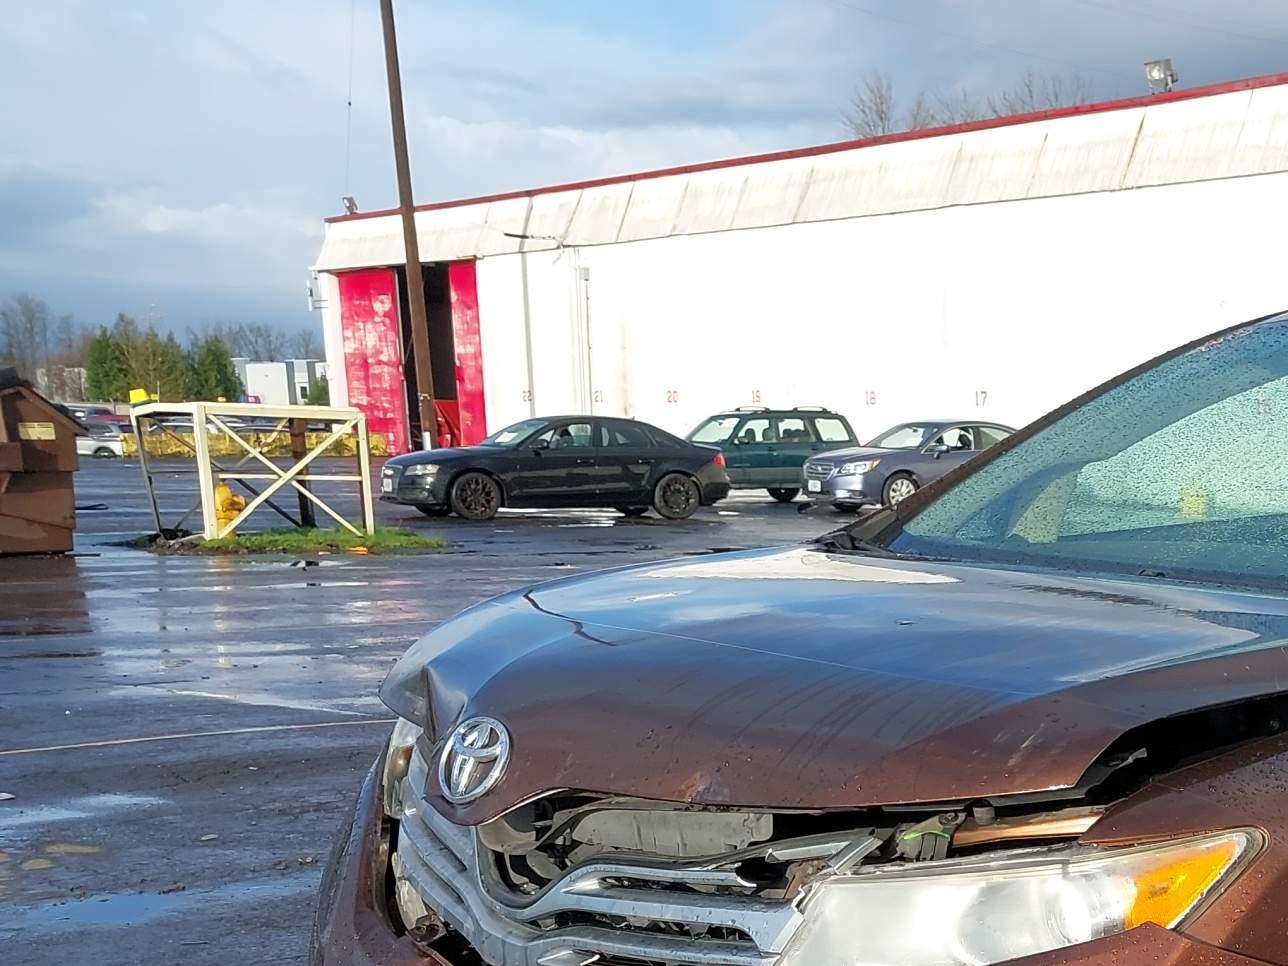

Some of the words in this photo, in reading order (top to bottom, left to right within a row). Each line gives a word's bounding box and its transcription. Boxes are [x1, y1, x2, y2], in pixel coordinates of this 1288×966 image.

[593, 390, 604, 403] 21
[666, 390, 679, 404] 20
[751, 389, 762, 404] 19
[974, 390, 987, 407] 17
